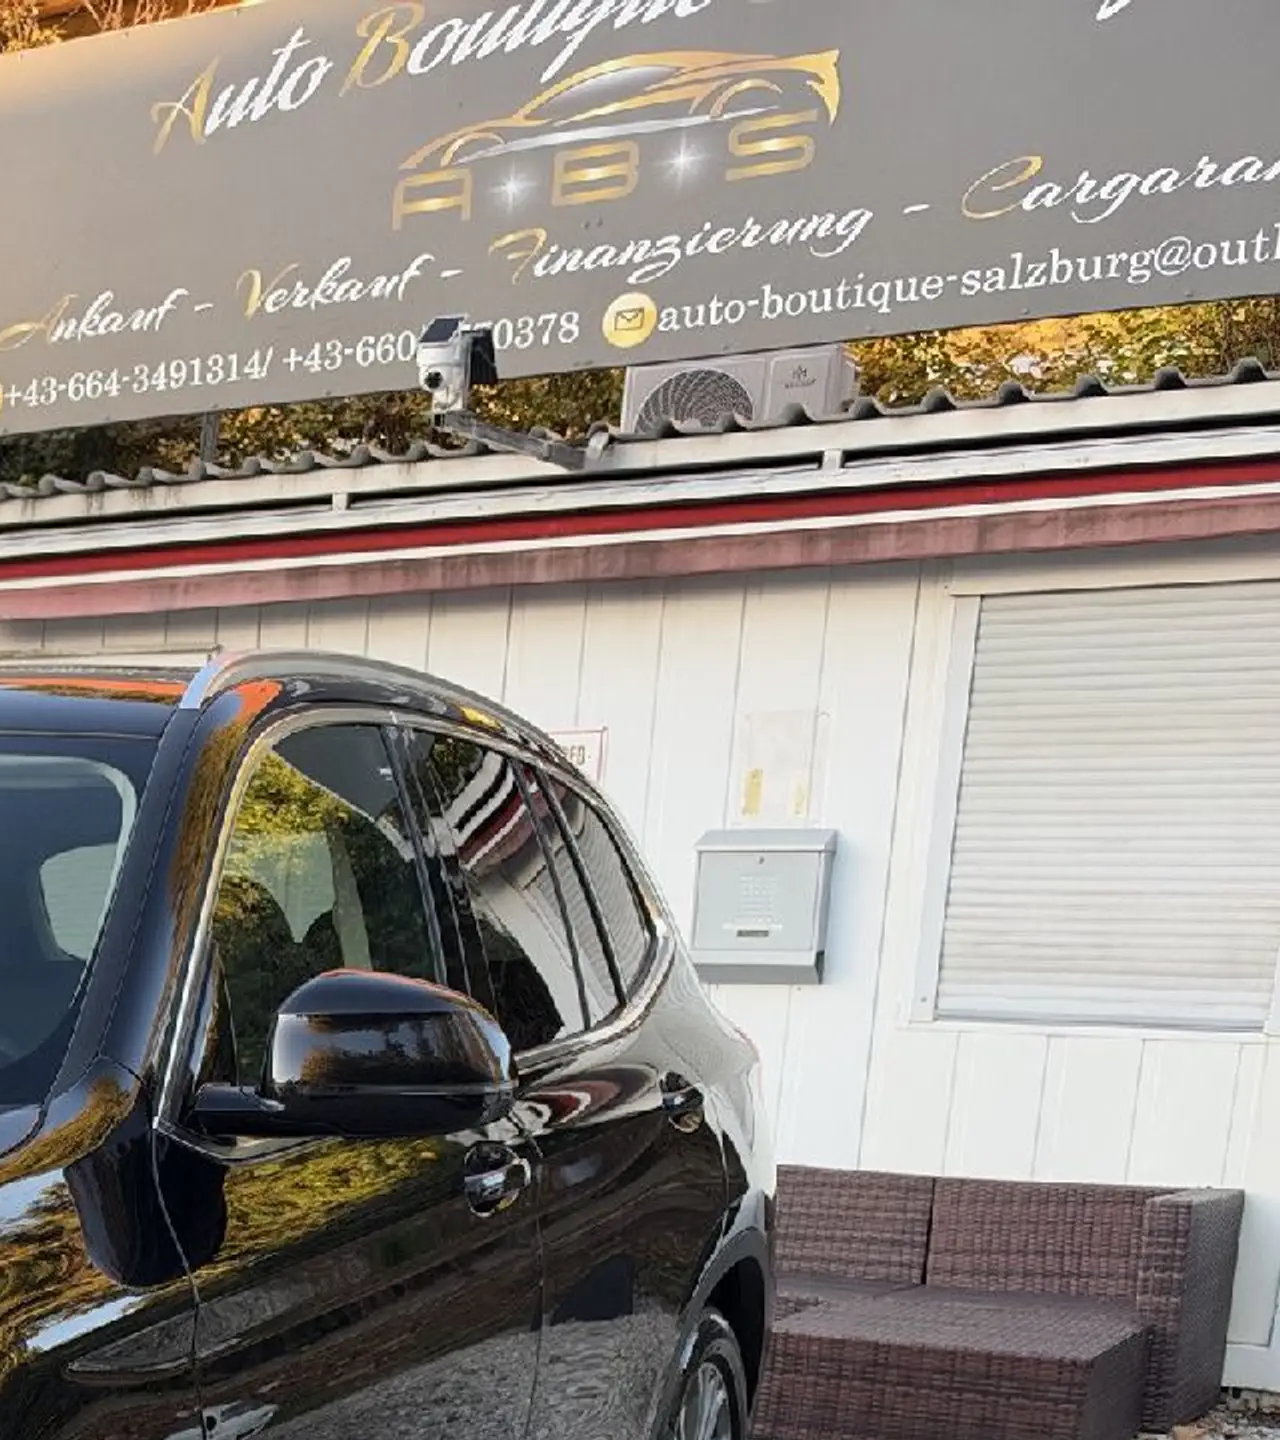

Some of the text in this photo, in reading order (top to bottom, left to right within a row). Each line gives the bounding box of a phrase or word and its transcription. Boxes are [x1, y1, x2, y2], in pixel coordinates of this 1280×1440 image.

[151, 27, 334, 155] Auto
[236, 254, 435, 321] Verkauf
[488, 207, 873, 285] Finanzierung
[4, 346, 274, 408] +43-664-3491314/
